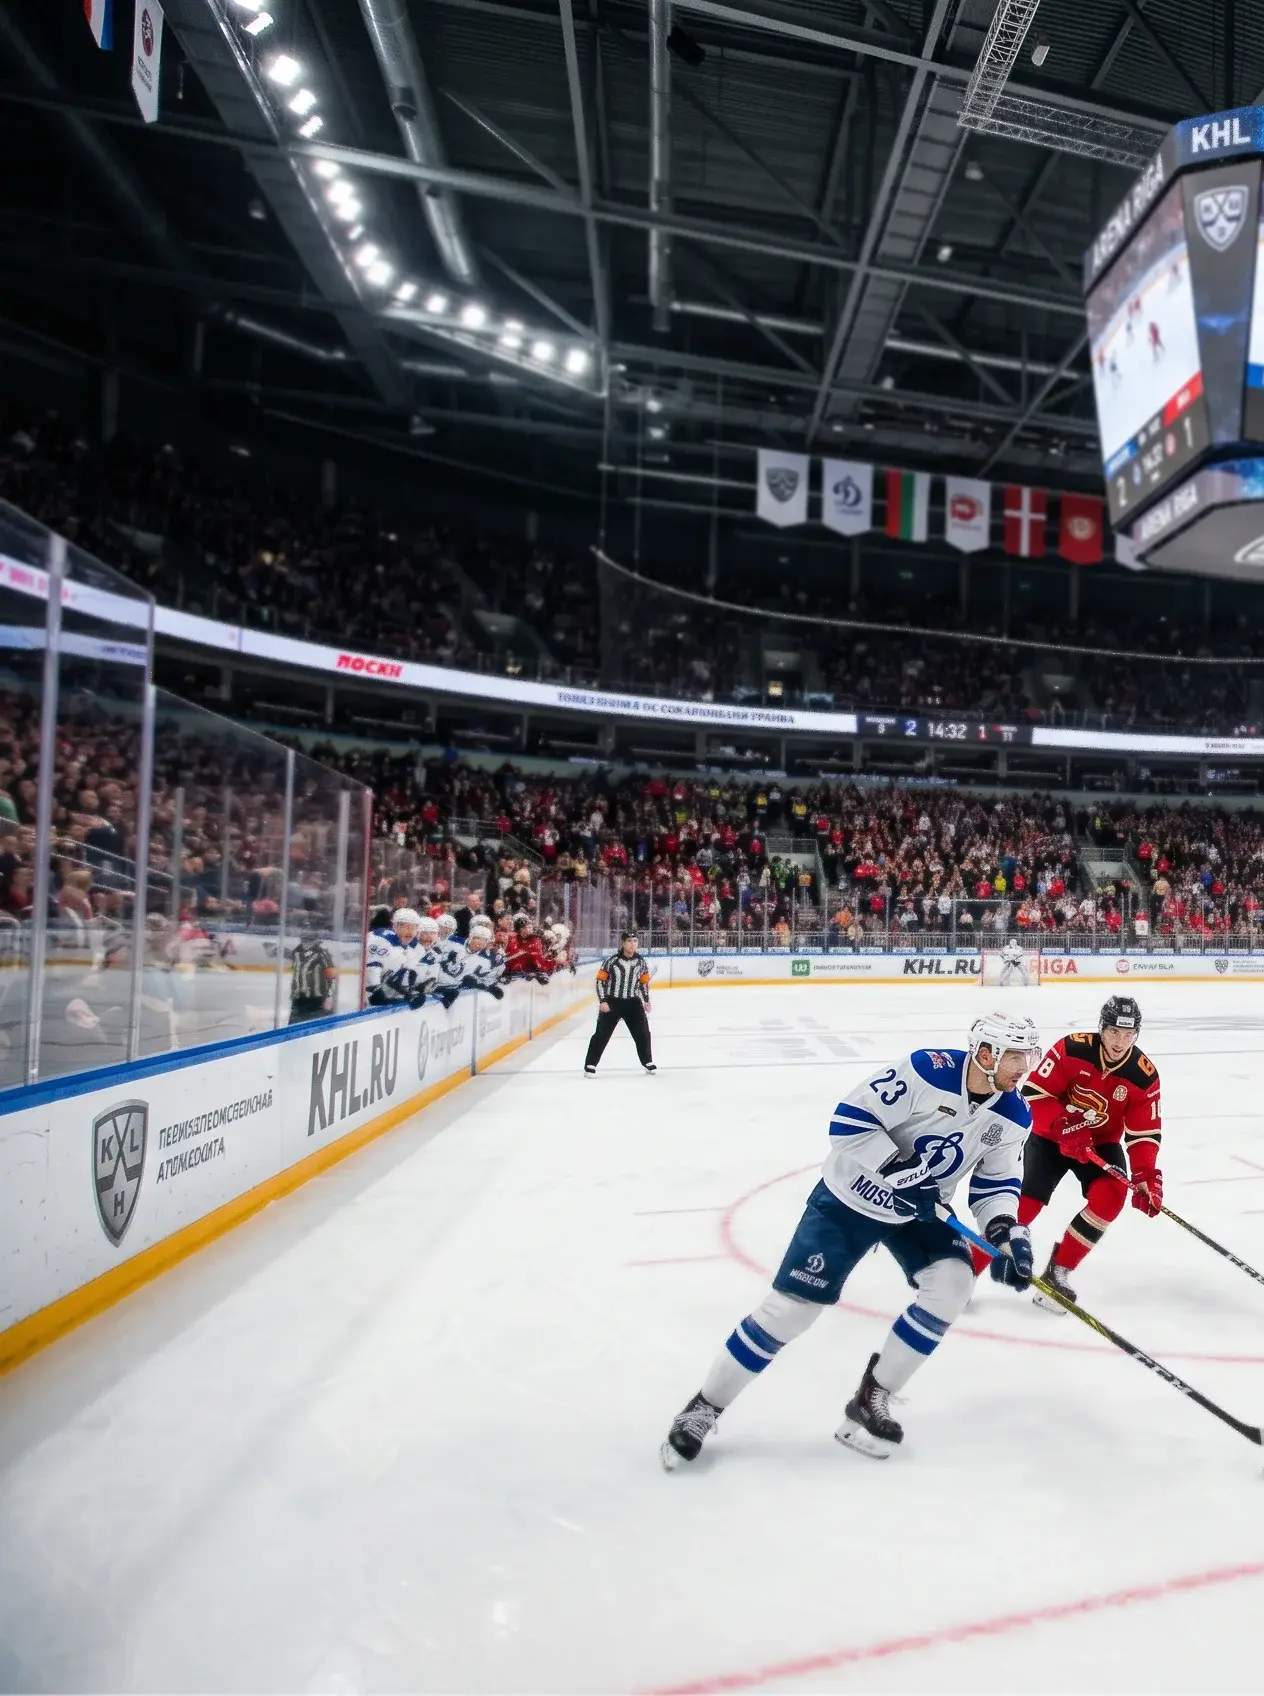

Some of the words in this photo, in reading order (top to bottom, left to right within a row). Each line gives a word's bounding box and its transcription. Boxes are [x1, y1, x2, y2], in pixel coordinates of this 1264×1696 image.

[1192, 118, 1251, 153] KHL
[905, 719, 917, 736] 2
[927, 722, 968, 740] 14:32
[978, 724, 986, 741] 1
[903, 958, 982, 975] KHL.RU
[308, 1027, 400, 1136] KHL.RU
[869, 1068, 908, 1106] 23
